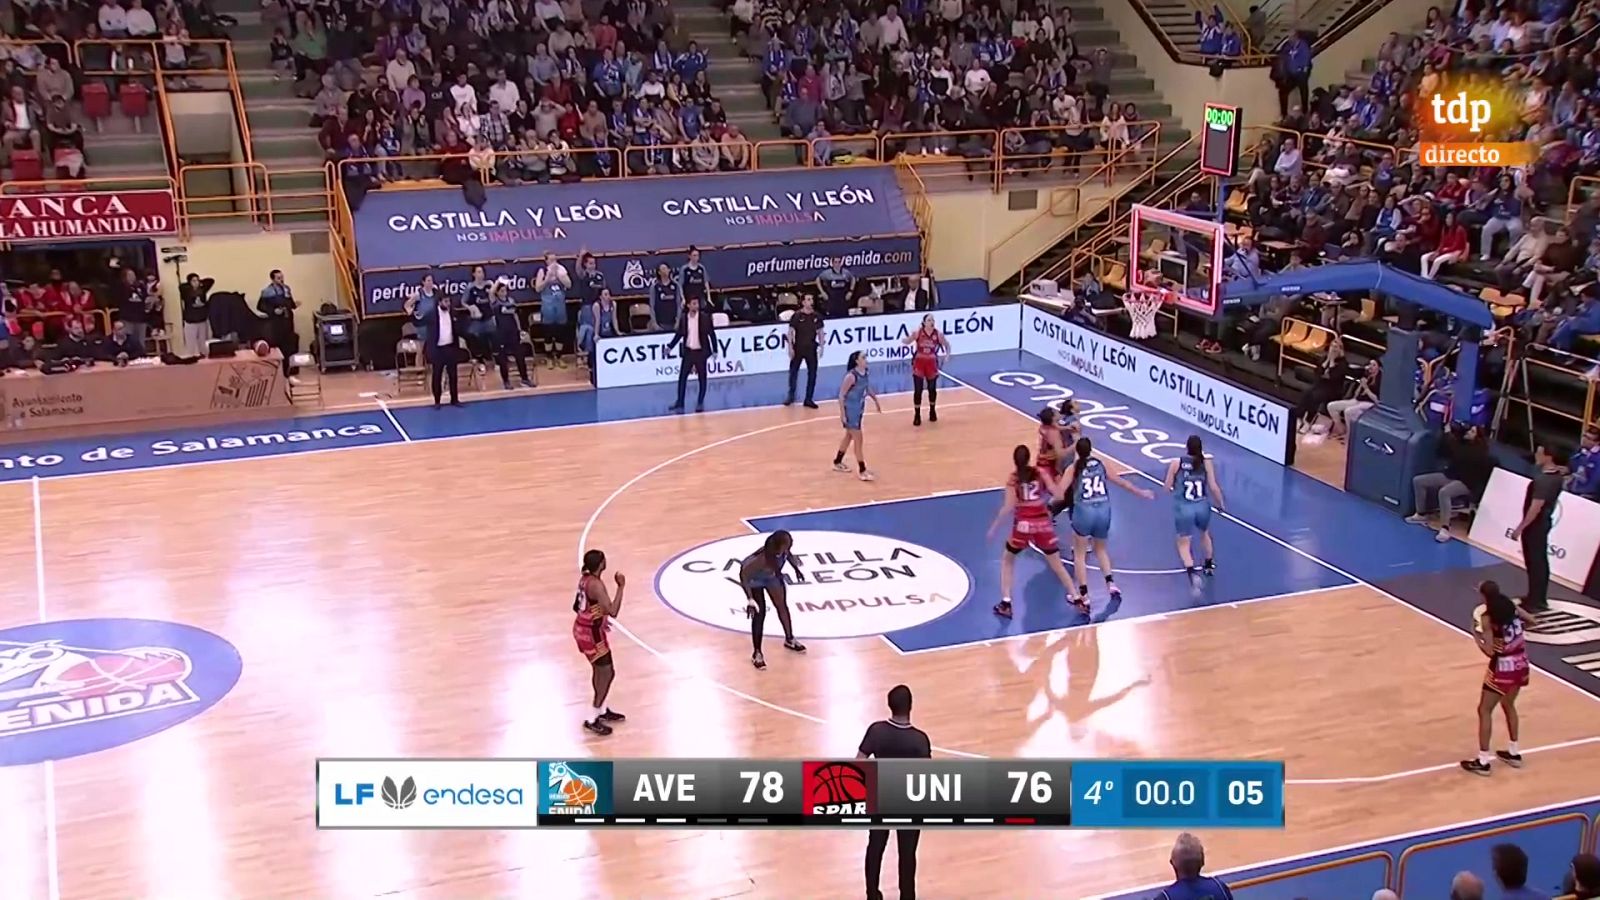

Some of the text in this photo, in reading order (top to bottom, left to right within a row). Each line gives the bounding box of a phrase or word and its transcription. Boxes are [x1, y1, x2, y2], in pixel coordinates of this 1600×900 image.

[1206, 107, 1233, 127] 00:00
[0, 195, 130, 219] ANCA
[662, 184, 875, 216] CASTILLA Y LEÓN
[32, 215, 167, 237] HUMANIDAD
[388, 199, 623, 232] CASTILLA Y LEÓN
[826, 311, 994, 345] ASTILLA LEÓN
[718, 337, 732, 358] Y
[1033, 316, 1137, 373] CASTILLA Y LEÓN
[1149, 364, 1280, 435] CASTILLA Y LEÓN
[81, 446, 135, 463] de
[151, 423, 383, 456] Salamanca
[1020, 480, 1042, 501] 12
[1081, 475, 1106, 499] 34
[1184, 480, 1204, 501] 21
[795, 592, 953, 613] IMPULSA
